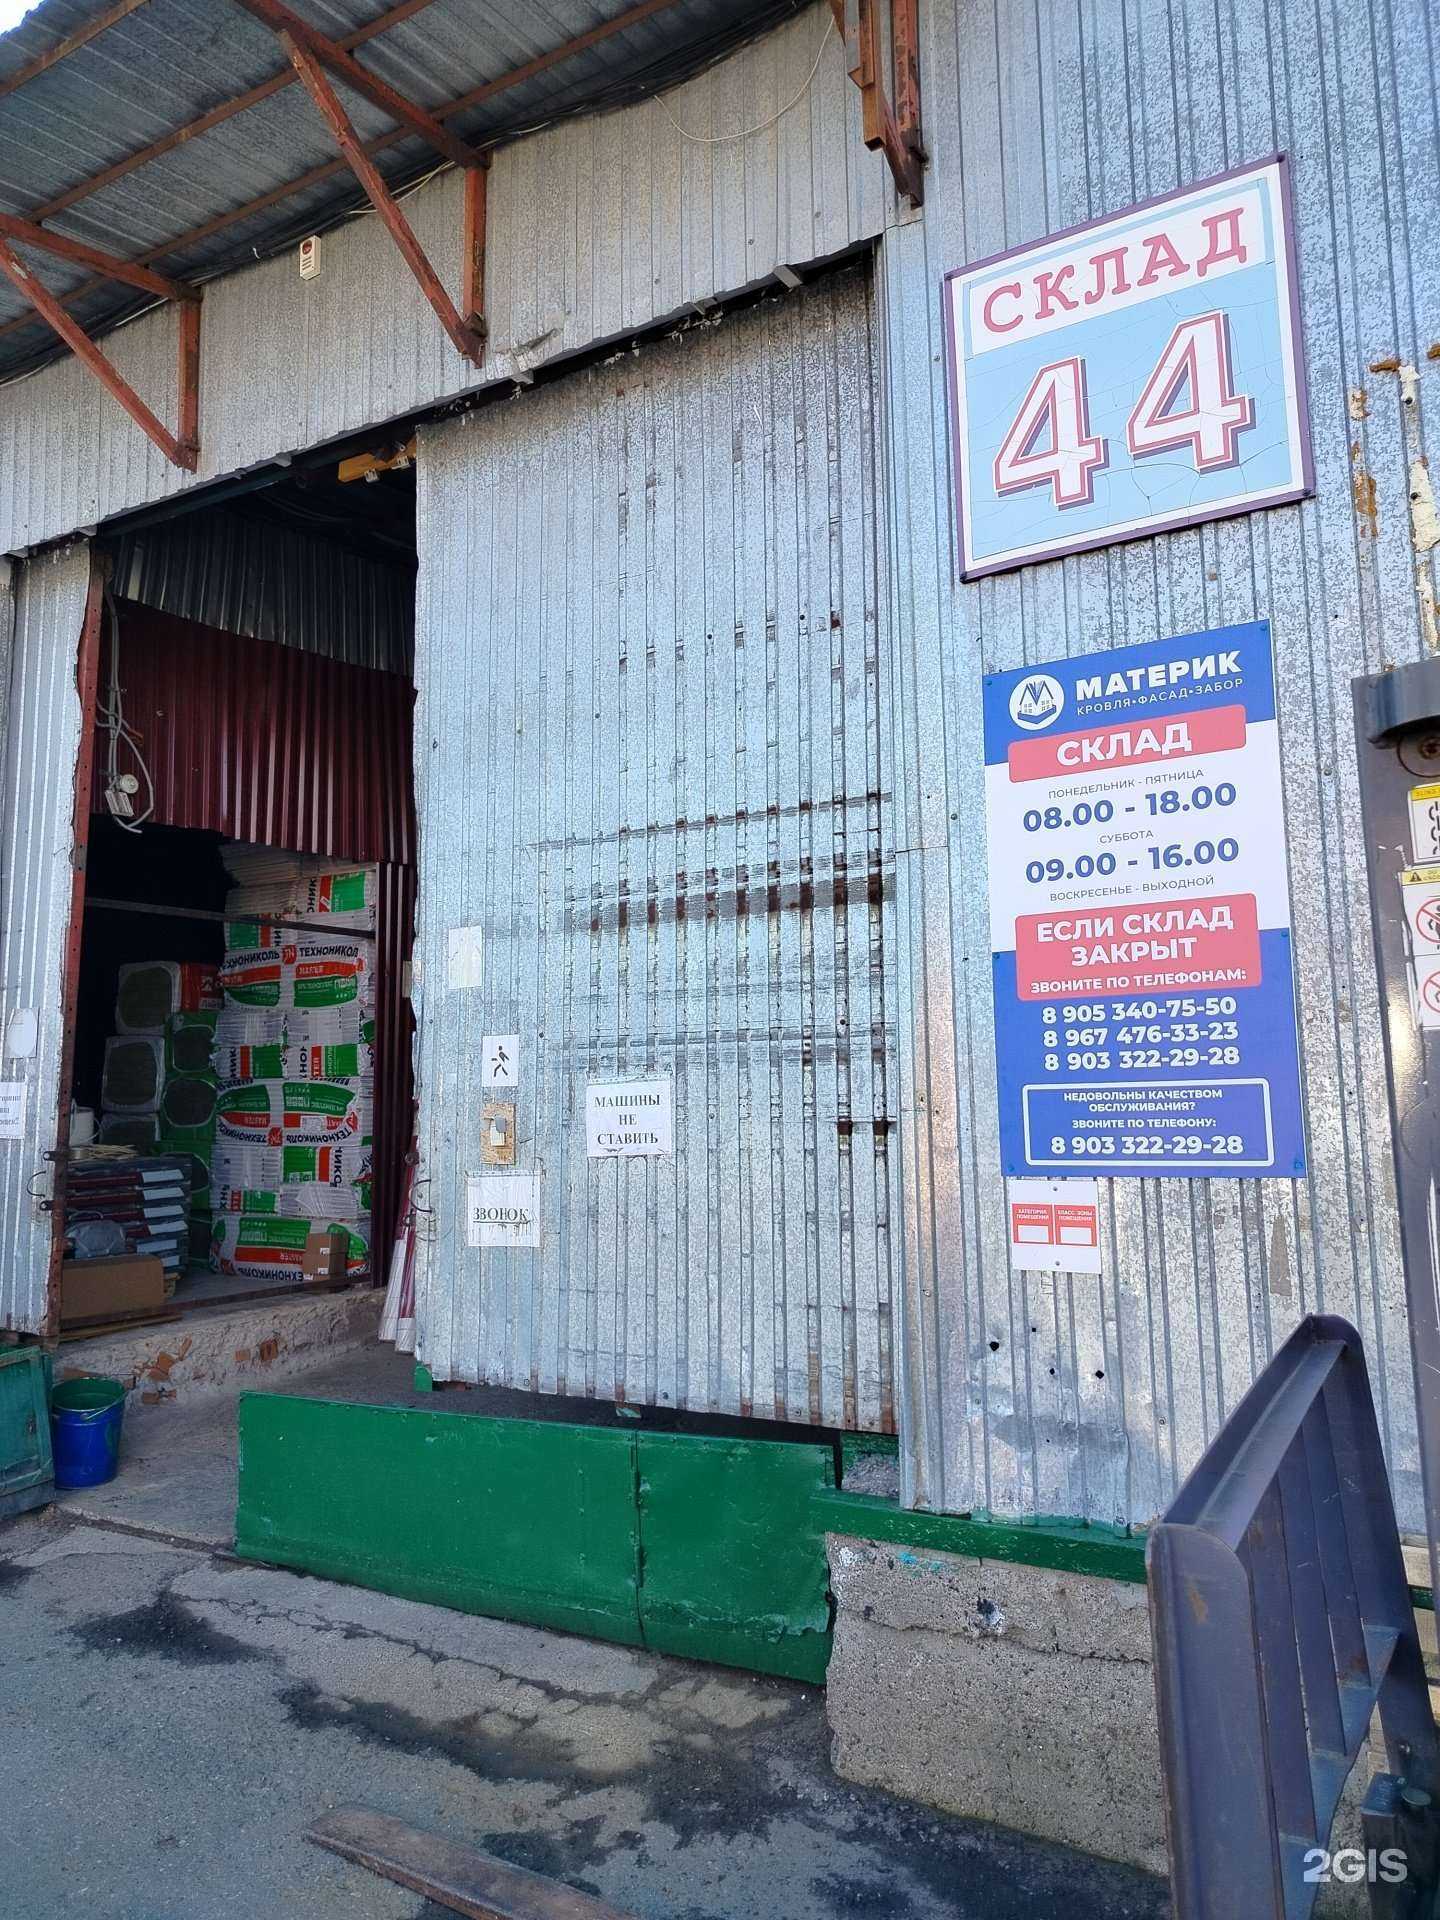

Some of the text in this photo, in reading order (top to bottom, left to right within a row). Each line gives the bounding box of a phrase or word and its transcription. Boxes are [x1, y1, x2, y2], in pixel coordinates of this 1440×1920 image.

[983, 207, 1248, 333] СКЛАД
[992, 309, 1257, 510] 44
[1076, 650, 1243, 702] МАТЕРИК
[1056, 722, 1193, 767] СКЛАД
[1048, 778, 1136, 800] ПОНЕДЕЛЬНИК
[1145, 768, 1205, 787] ПЯТНИЦА
[1022, 799, 1115, 833] 08.00
[1145, 782, 1238, 816] 18.00
[1099, 830, 1155, 845] СУББОТА
[1025, 852, 1117, 885] 09.00
[1148, 837, 1240, 871] 16.00
[1049, 884, 1133, 903] ВОСКРЕСЕНЬЕ
[1142, 875, 1215, 894] ВЫХОДНОЙ
[1037, 905, 1234, 943] ЕСЛИ СКЛАД
[1070, 936, 1198, 967] ЗАКРЫТ
[1030, 967, 1247, 995] ЗВОНИТЕ ПО ТЕЛЕФОНАМ:
[1042, 996, 1237, 1024] 8 905 340-75-50
[1042, 1021, 1239, 1048] 8 967 476-33-23
[1044, 1046, 1240, 1071] 8 903 322-29-28
[594, 1095, 661, 1109] МАШИНЫ
[1063, 1088, 1223, 1104] НЕДОВОЛЬНЫ КАЧЕСТВОМ
[1088, 1101, 1196, 1113] ОБСЛУЖИВАНИЯ?
[618, 1114, 637, 1127] НЕ
[1072, 1117, 1217, 1130] ЗВОНИТЕ ПО ТЕЛЕФОНУ:
[597, 1131, 659, 1146] СТАВИТЬ
[1051, 1135, 1244, 1155] 8 903 322-29-28
[472, 1206, 530, 1223] ЗВОНОК
